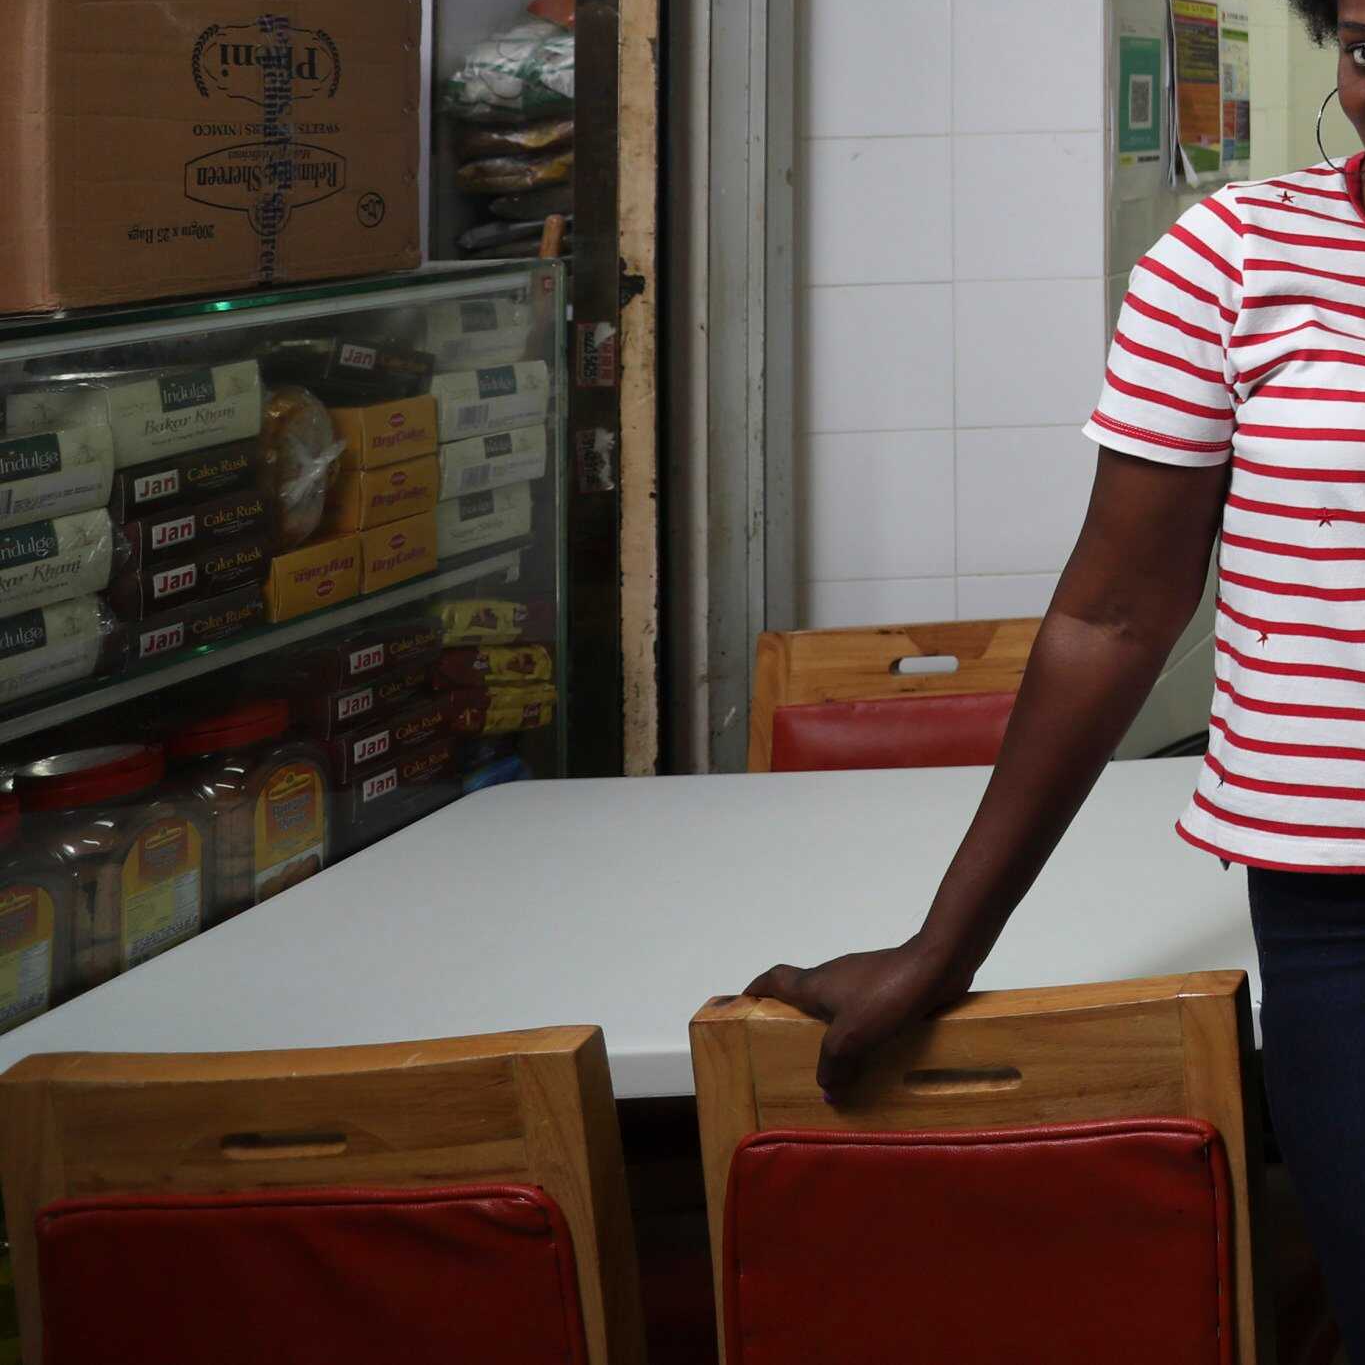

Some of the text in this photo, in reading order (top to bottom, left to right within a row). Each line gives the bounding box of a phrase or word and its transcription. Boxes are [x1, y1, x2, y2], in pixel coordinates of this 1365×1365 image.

[343, 347, 374, 365] Jan
[140, 475, 176, 497] Jan
[236, 499, 265, 518] Rusk
[157, 521, 193, 544] Jan
[0, 535, 56, 560] ndulge
[236, 546, 263, 566] Rusk
[159, 569, 194, 593] Jan
[0, 624, 44, 648] dulge
[144, 628, 182, 653] Jan
[354, 650, 382, 670] Jan
[341, 694, 370, 716] Jan
[358, 737, 387, 759] Jan
[366, 774, 396, 797] Jan
